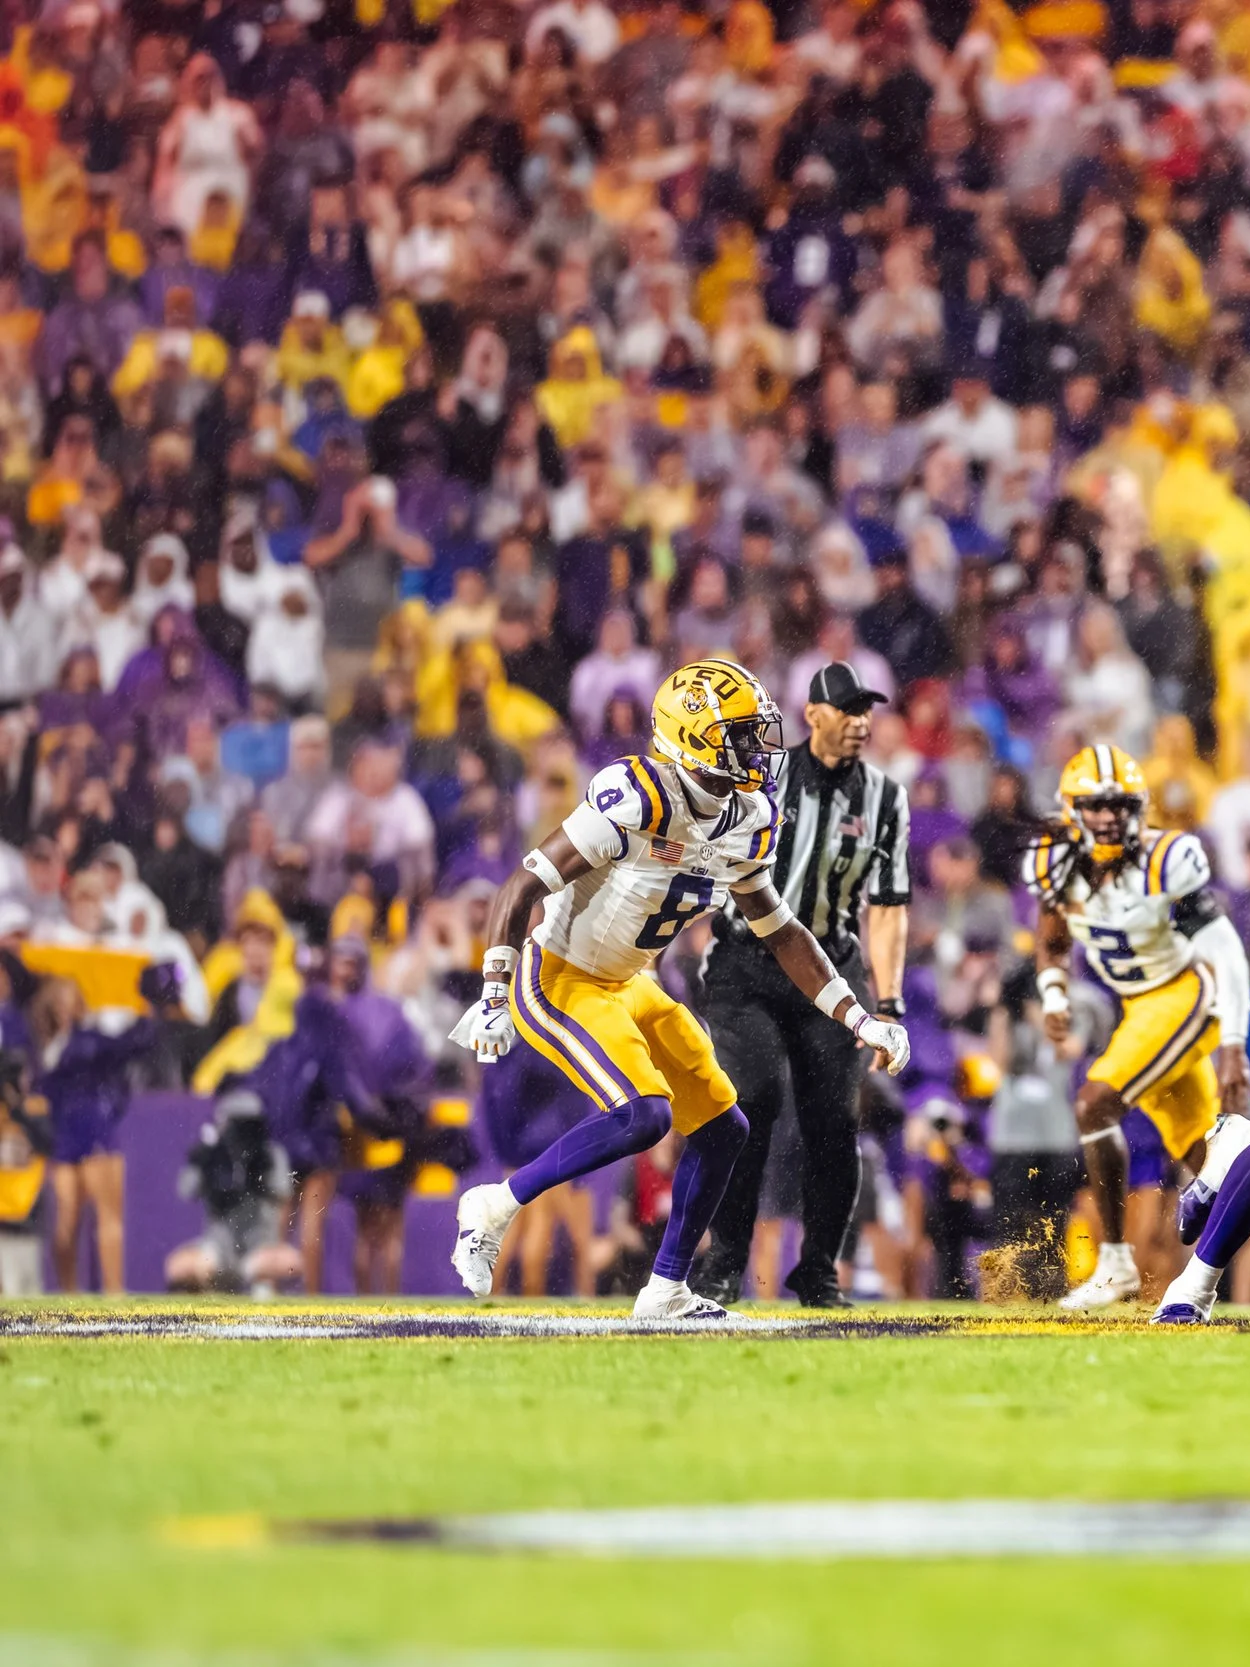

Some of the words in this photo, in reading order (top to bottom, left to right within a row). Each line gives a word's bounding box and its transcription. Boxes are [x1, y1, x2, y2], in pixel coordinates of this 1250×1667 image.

[672, 669, 739, 700] LSU
[596, 787, 625, 813] 8
[690, 866, 709, 876] LSU
[1184, 847, 1203, 873] 2
[635, 872, 715, 950] 8
[1088, 926, 1147, 981] 2
